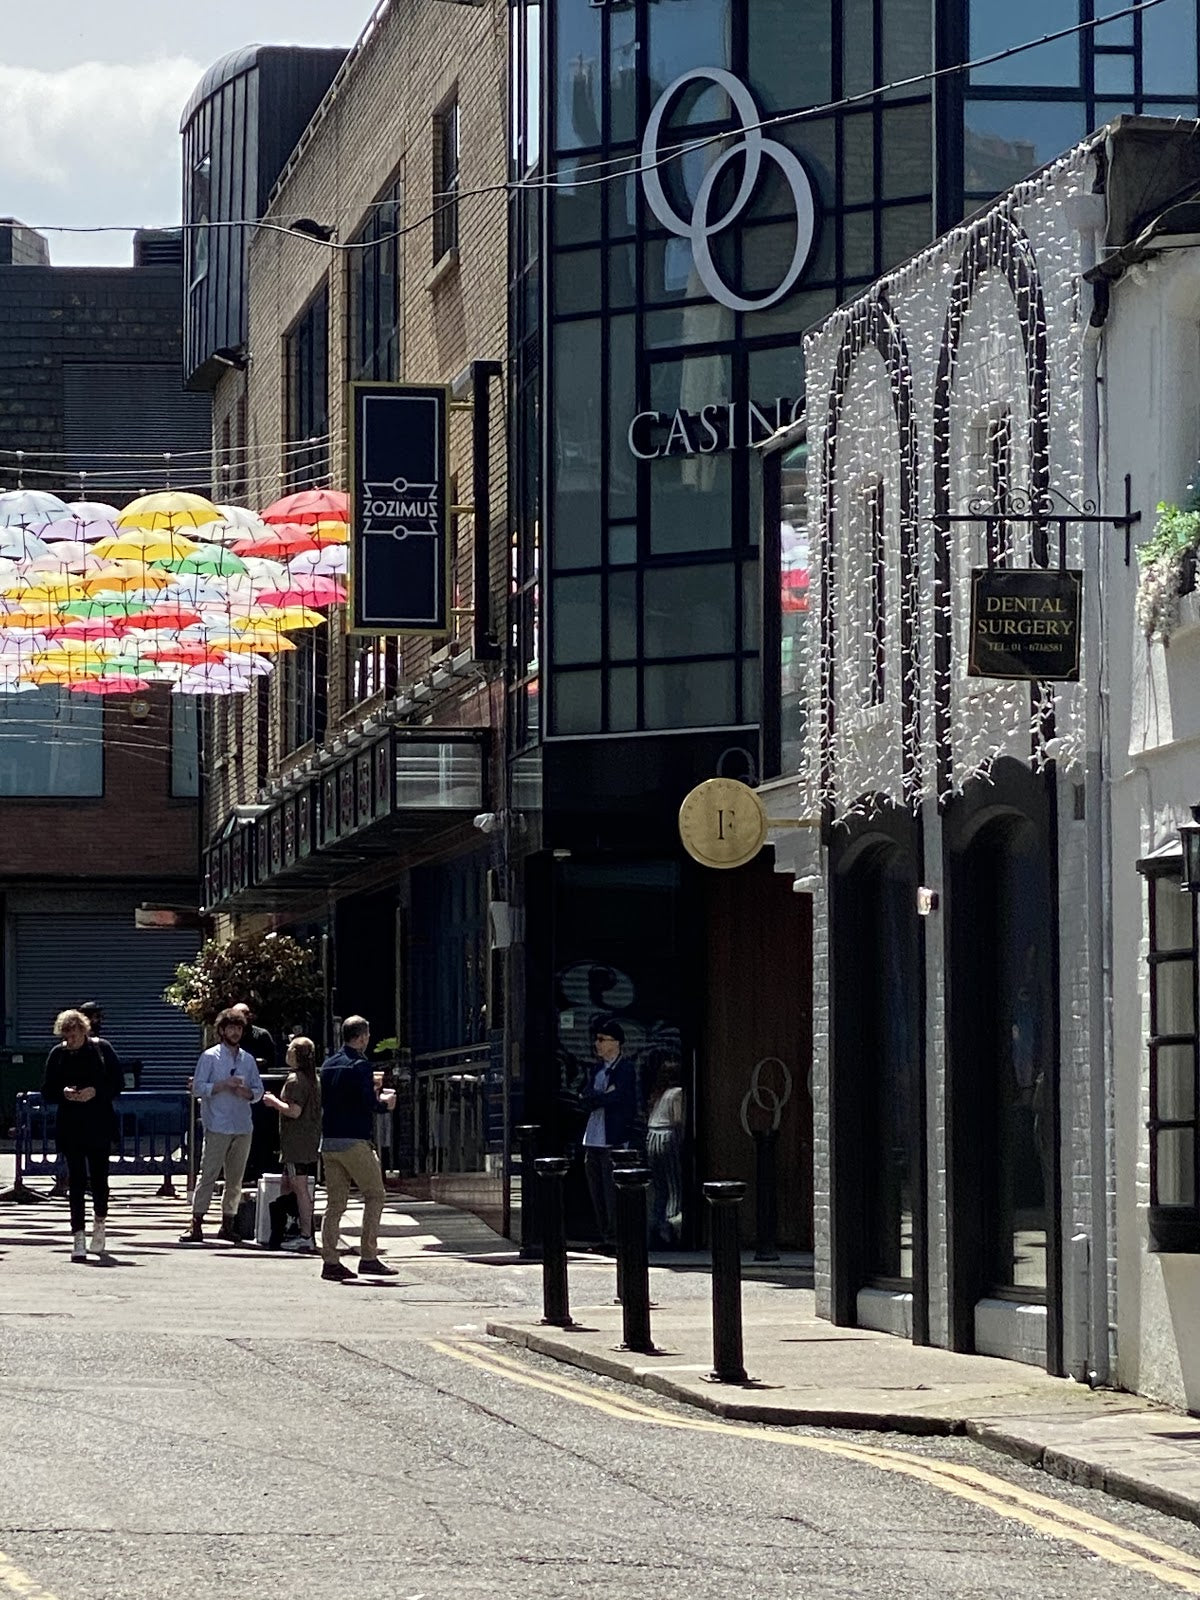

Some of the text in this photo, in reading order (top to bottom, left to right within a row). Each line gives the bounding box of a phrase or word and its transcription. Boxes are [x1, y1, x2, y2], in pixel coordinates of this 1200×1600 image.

[362, 499, 439, 518] ZOZIMUS
[986, 597, 1066, 613] DENTAL
[978, 619, 1074, 635] SURGERY
